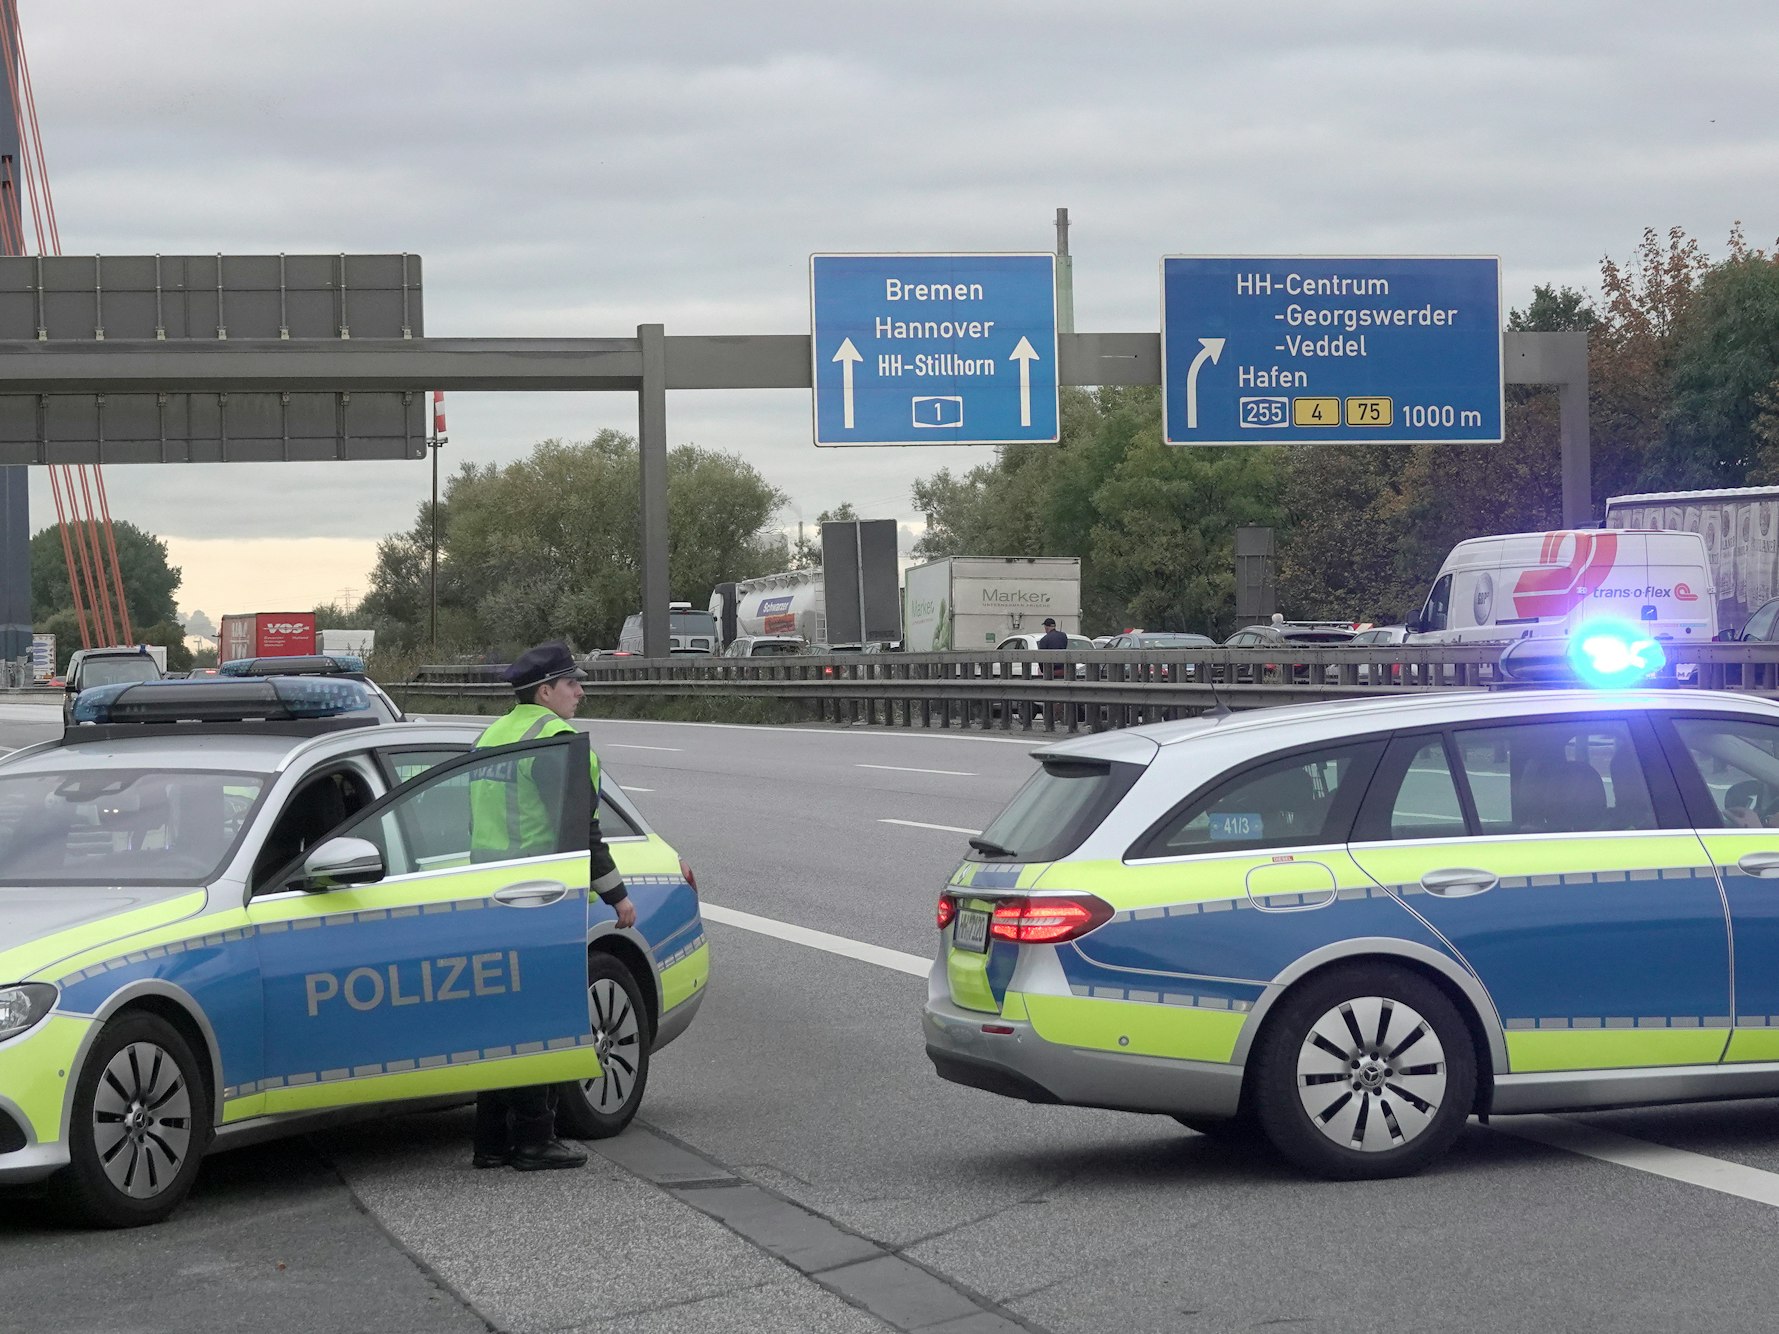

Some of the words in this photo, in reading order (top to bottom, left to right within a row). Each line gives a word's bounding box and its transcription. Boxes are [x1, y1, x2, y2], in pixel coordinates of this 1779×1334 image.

[886, 278, 983, 301] Bremen
[1237, 273, 1389, 296] HH-Centrum
[875, 317, 995, 339] Hannover
[1274, 304, 1458, 331] -Georgswerder
[1275, 335, 1367, 357] -Veddel
[878, 354, 995, 377] HH-Stillhorn
[1238, 366, 1309, 388] Hafen
[934, 403, 942, 422] 1
[1246, 404, 1282, 422] 255
[1311, 403, 1323, 421] 4
[1357, 403, 1381, 421] 75
[1403, 406, 1455, 427] 1000
[1460, 410, 1482, 427] m
[763, 601, 790, 613] Schwarzer
[1224, 817, 1250, 834] 41/3
[305, 950, 521, 1017] POLIZEI
